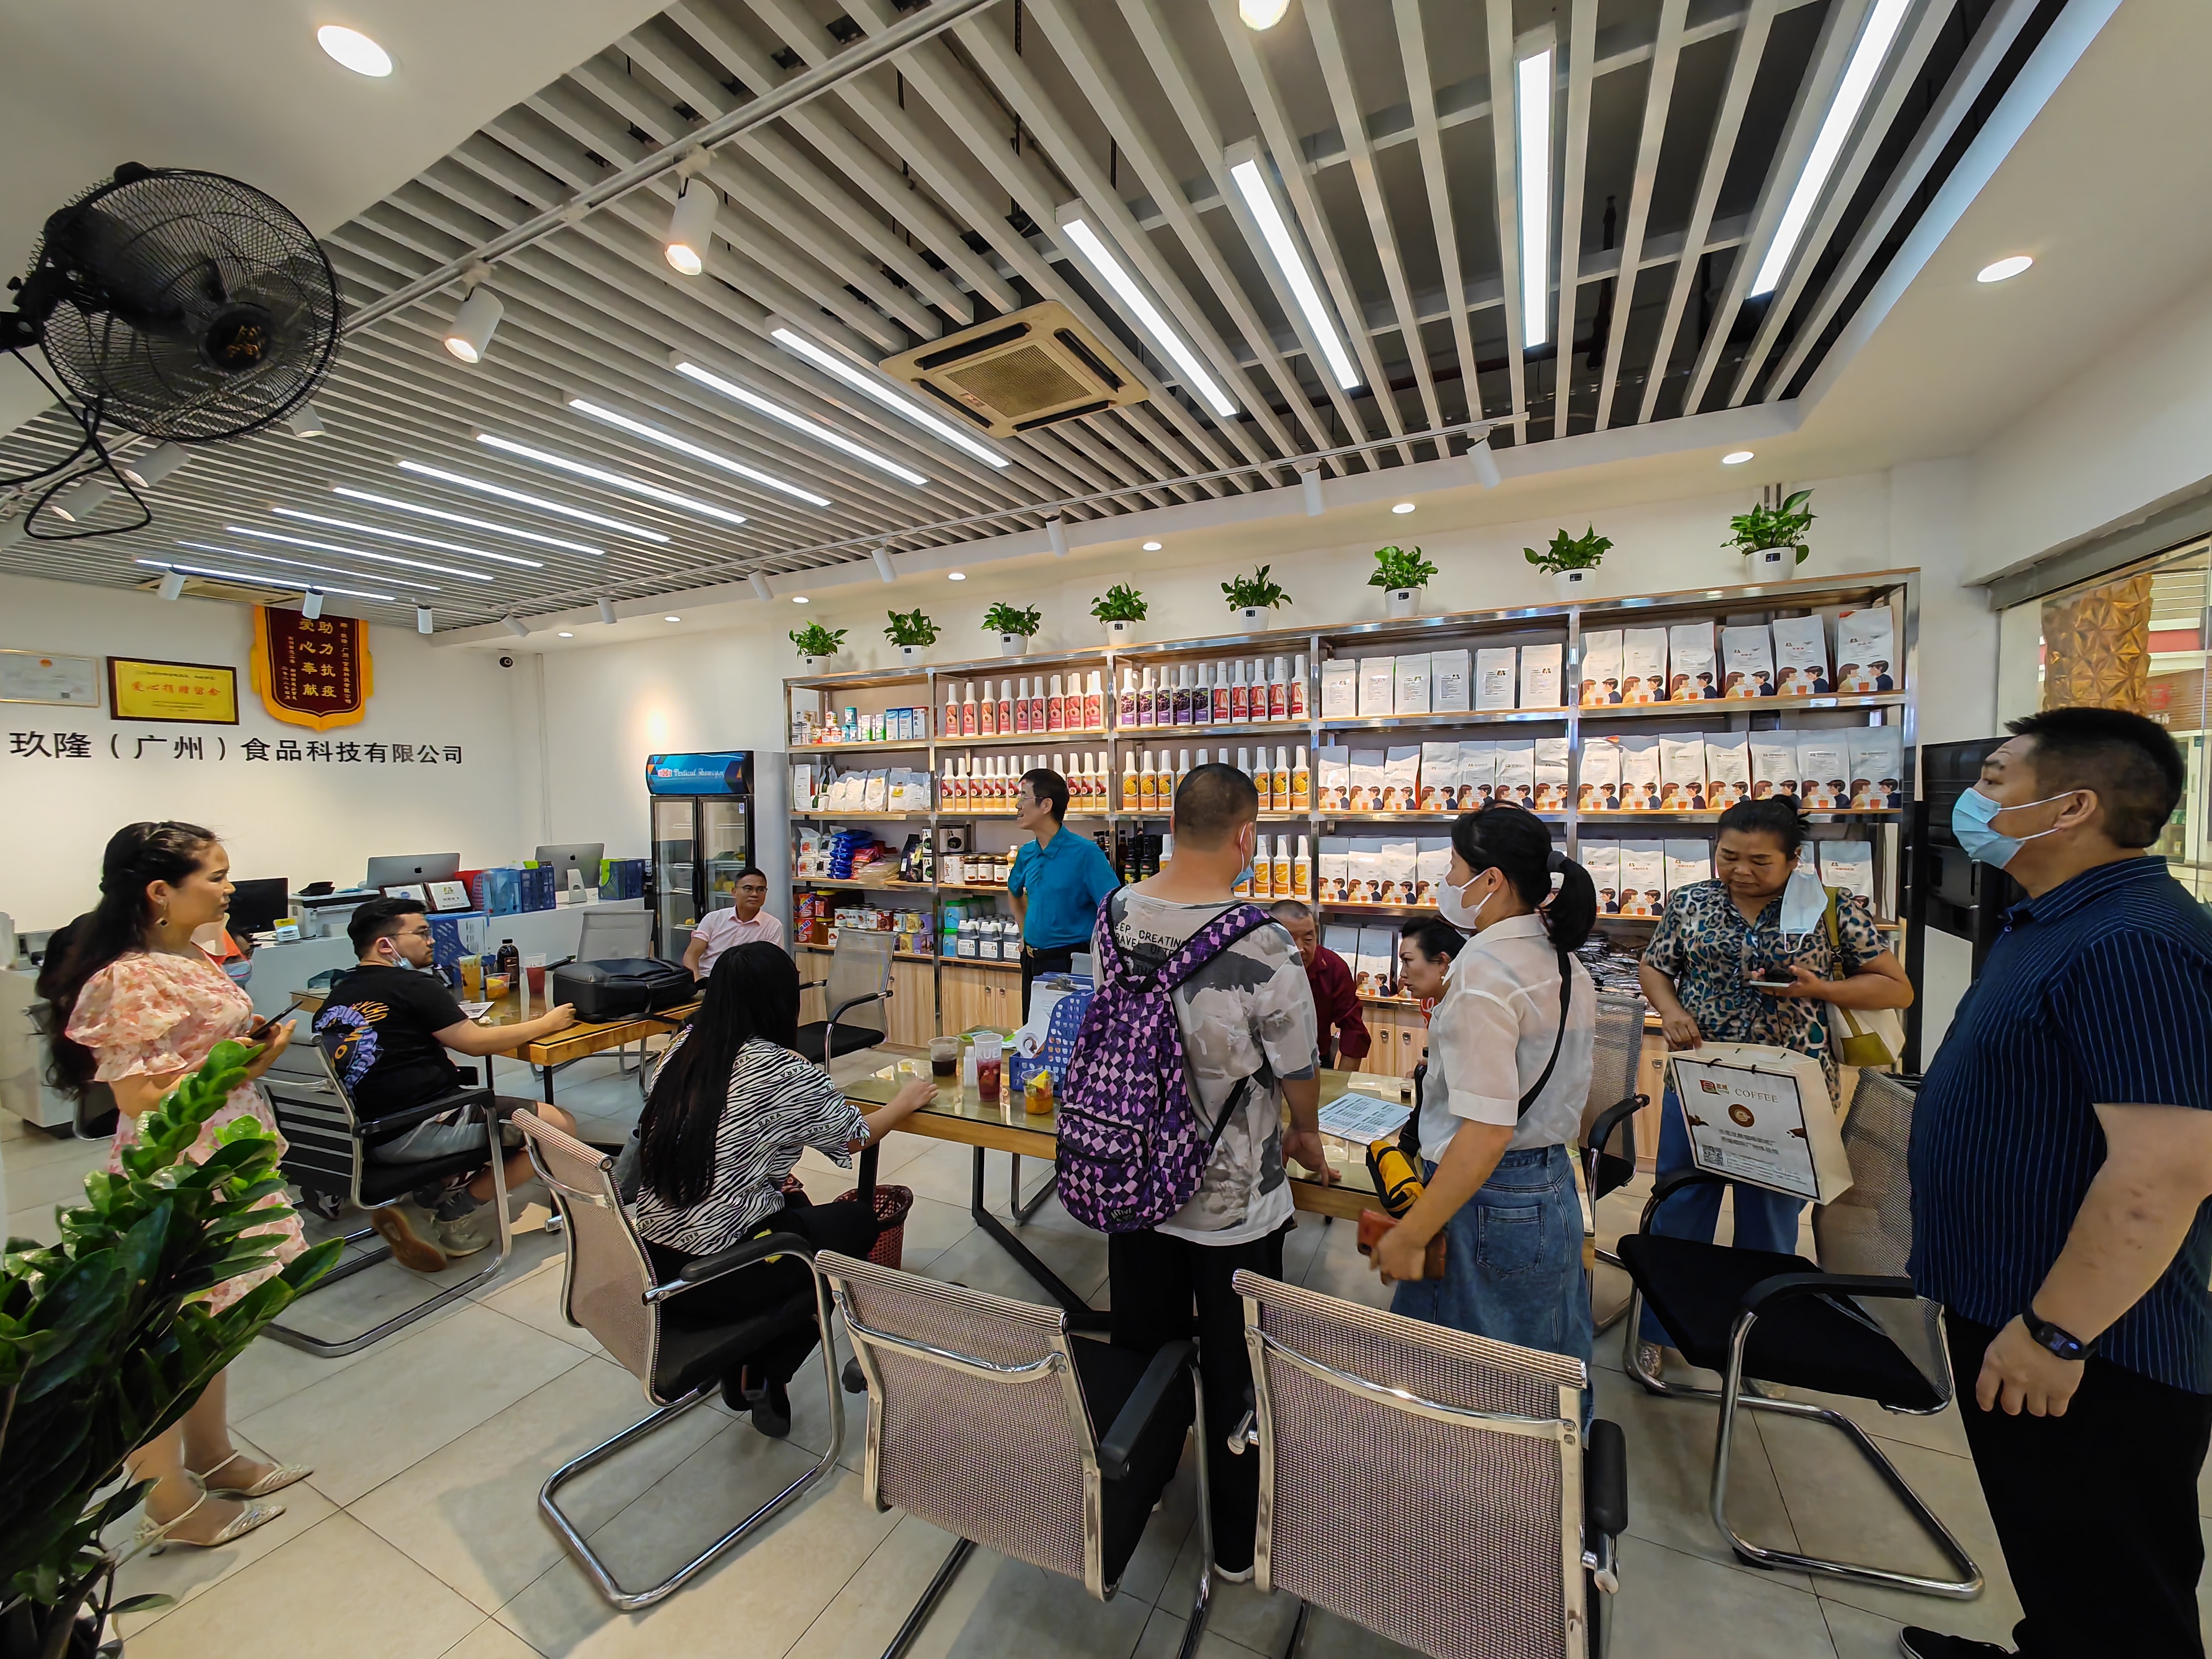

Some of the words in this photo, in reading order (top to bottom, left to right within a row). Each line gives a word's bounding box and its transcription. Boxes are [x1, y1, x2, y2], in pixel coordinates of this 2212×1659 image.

[298, 618, 319, 697] 爱心奉献
[317, 621, 337, 698] 助力抗疫
[1138, 930, 1183, 949] CREATIN
[734, 1055, 750, 1067] ARA
[1735, 1088, 1779, 1103] COFFEE
[758, 1112, 782, 1127] RARA
